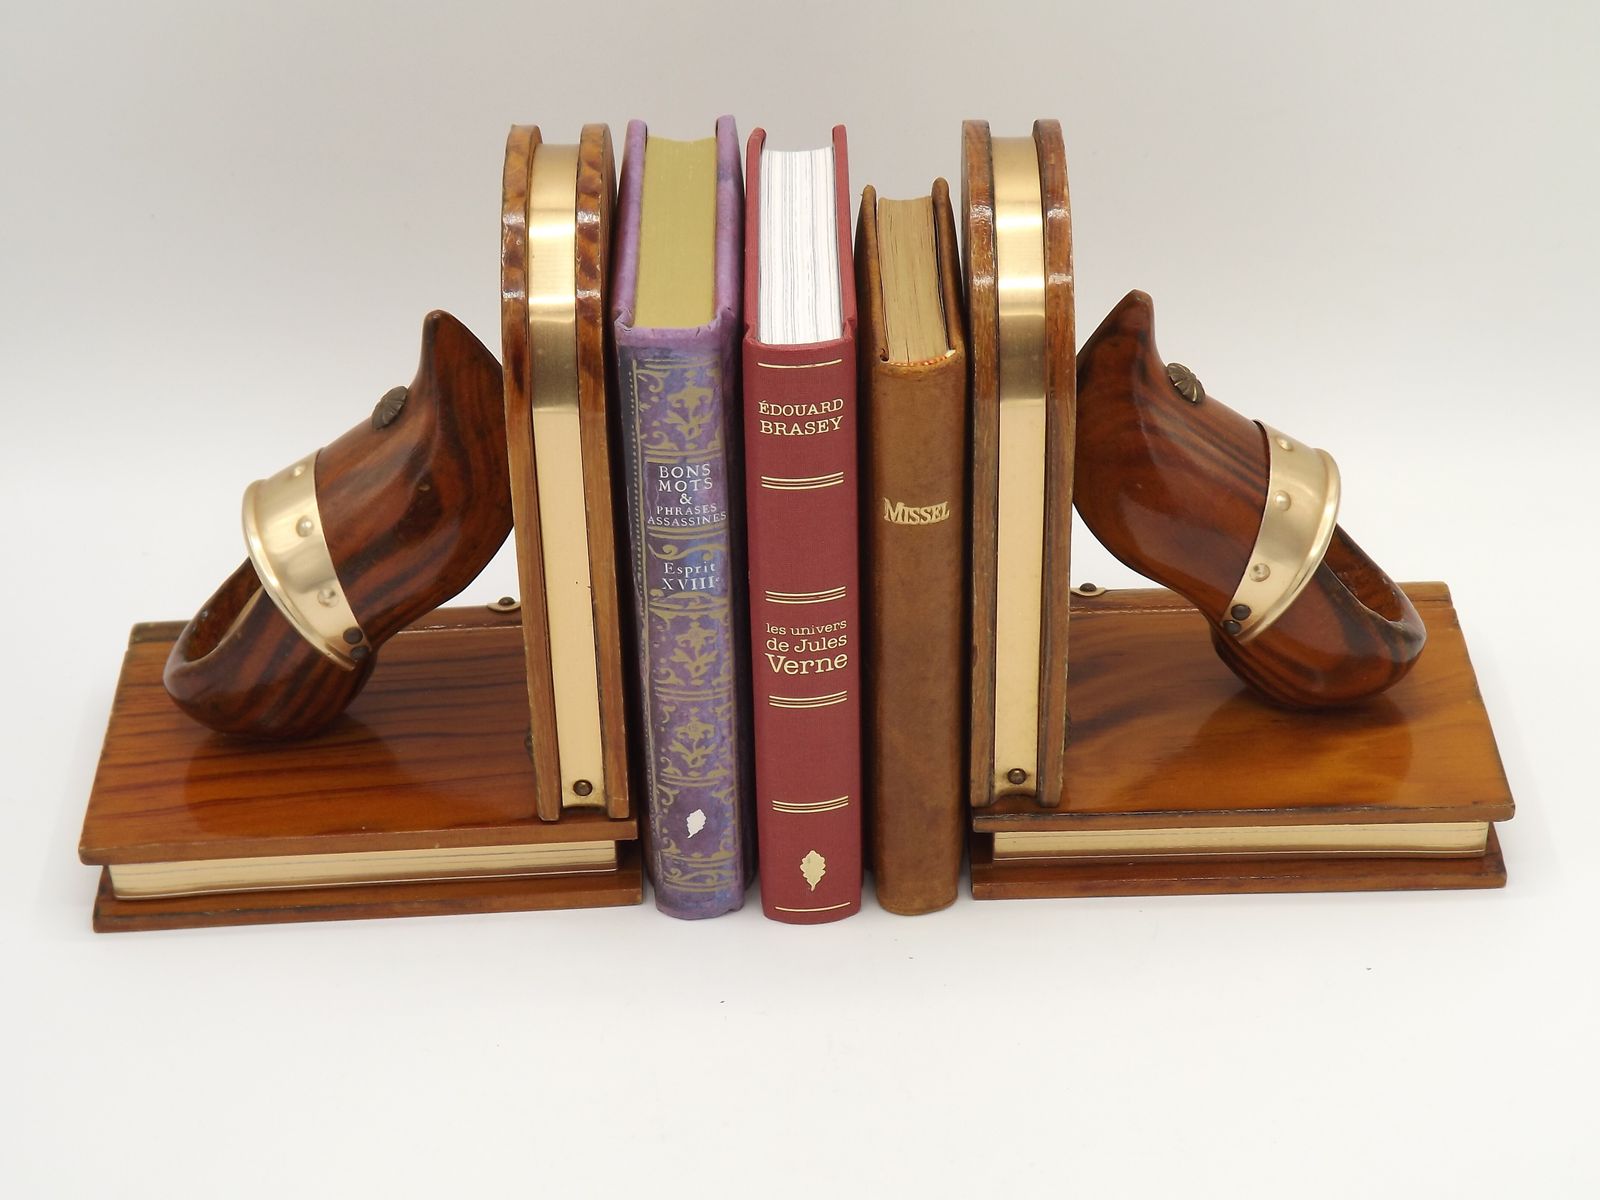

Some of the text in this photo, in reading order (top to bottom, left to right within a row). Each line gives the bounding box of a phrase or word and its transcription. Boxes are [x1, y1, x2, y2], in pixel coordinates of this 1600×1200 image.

[758, 398, 844, 416] ÉDOUARD
[759, 416, 843, 436] BRASEY
[659, 464, 711, 479] BONS
[659, 477, 713, 492] MOTS
[679, 493, 693, 505] &
[656, 503, 717, 515] PHRASES
[647, 511, 727, 527] ASSASSINES
[664, 561, 716, 578] Esprit
[766, 619, 847, 636] les univers
[766, 634, 847, 653] de Jules
[765, 652, 848, 675] Verne
